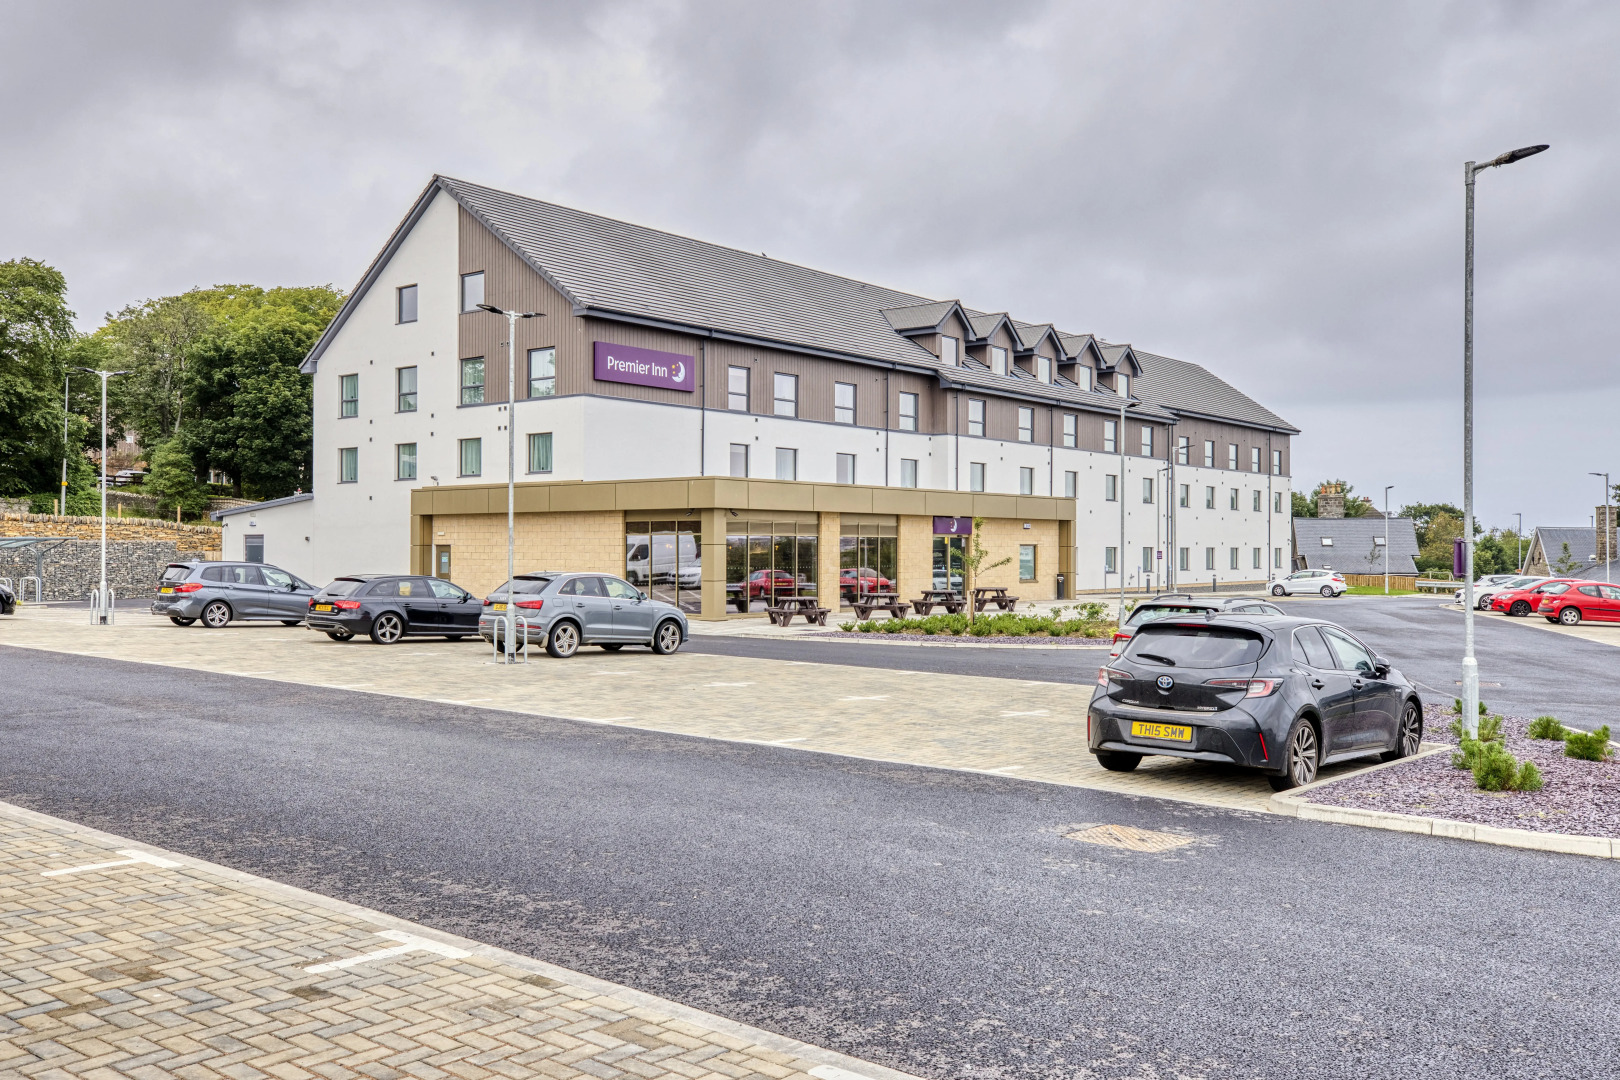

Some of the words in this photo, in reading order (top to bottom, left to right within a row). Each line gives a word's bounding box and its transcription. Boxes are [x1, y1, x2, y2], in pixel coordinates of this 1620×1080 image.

[607, 355, 650, 374] Premier
[652, 362, 668, 377] Inn
[1163, 726, 1185, 738] SMW
